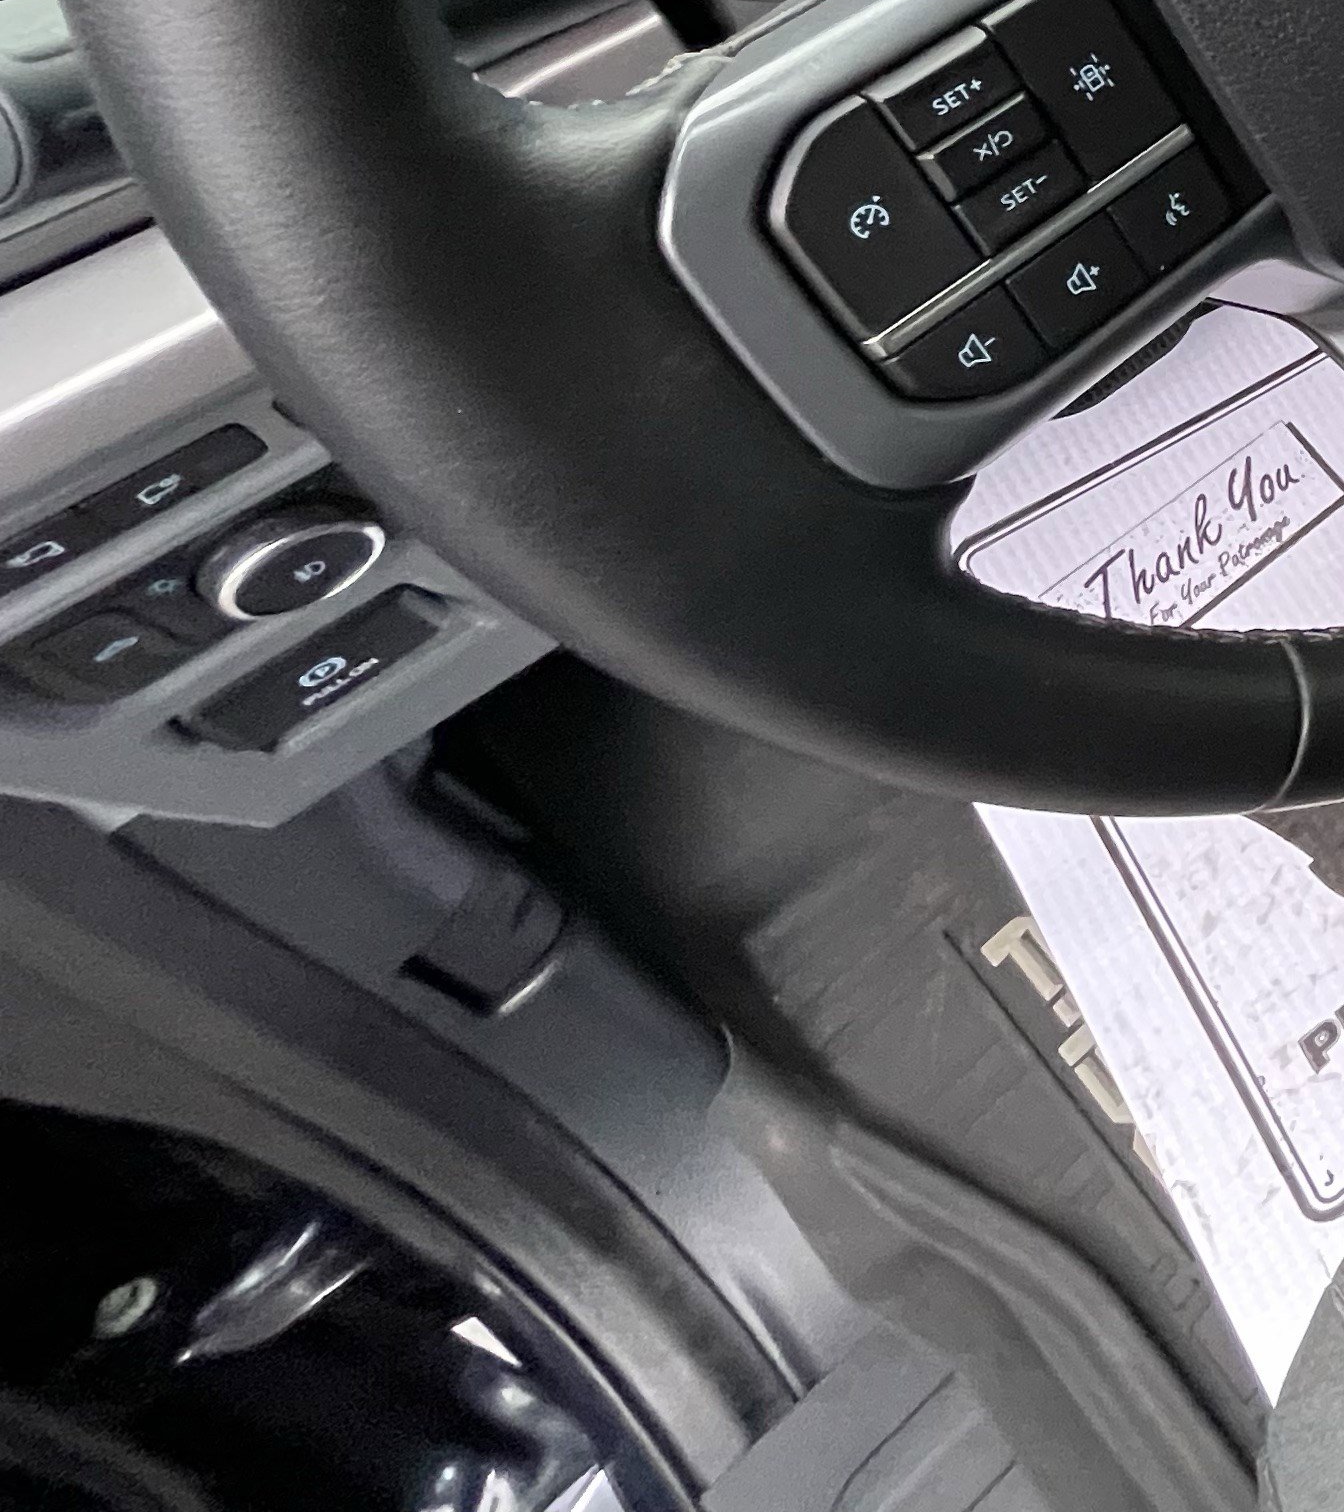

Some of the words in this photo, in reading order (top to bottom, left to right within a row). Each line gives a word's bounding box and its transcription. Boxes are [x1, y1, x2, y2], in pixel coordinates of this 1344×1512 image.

[932, 76, 982, 116] SET+
[1084, 493, 1223, 621] Thank
[1227, 455, 1301, 522] You
[1180, 572, 1217, 605] Your
